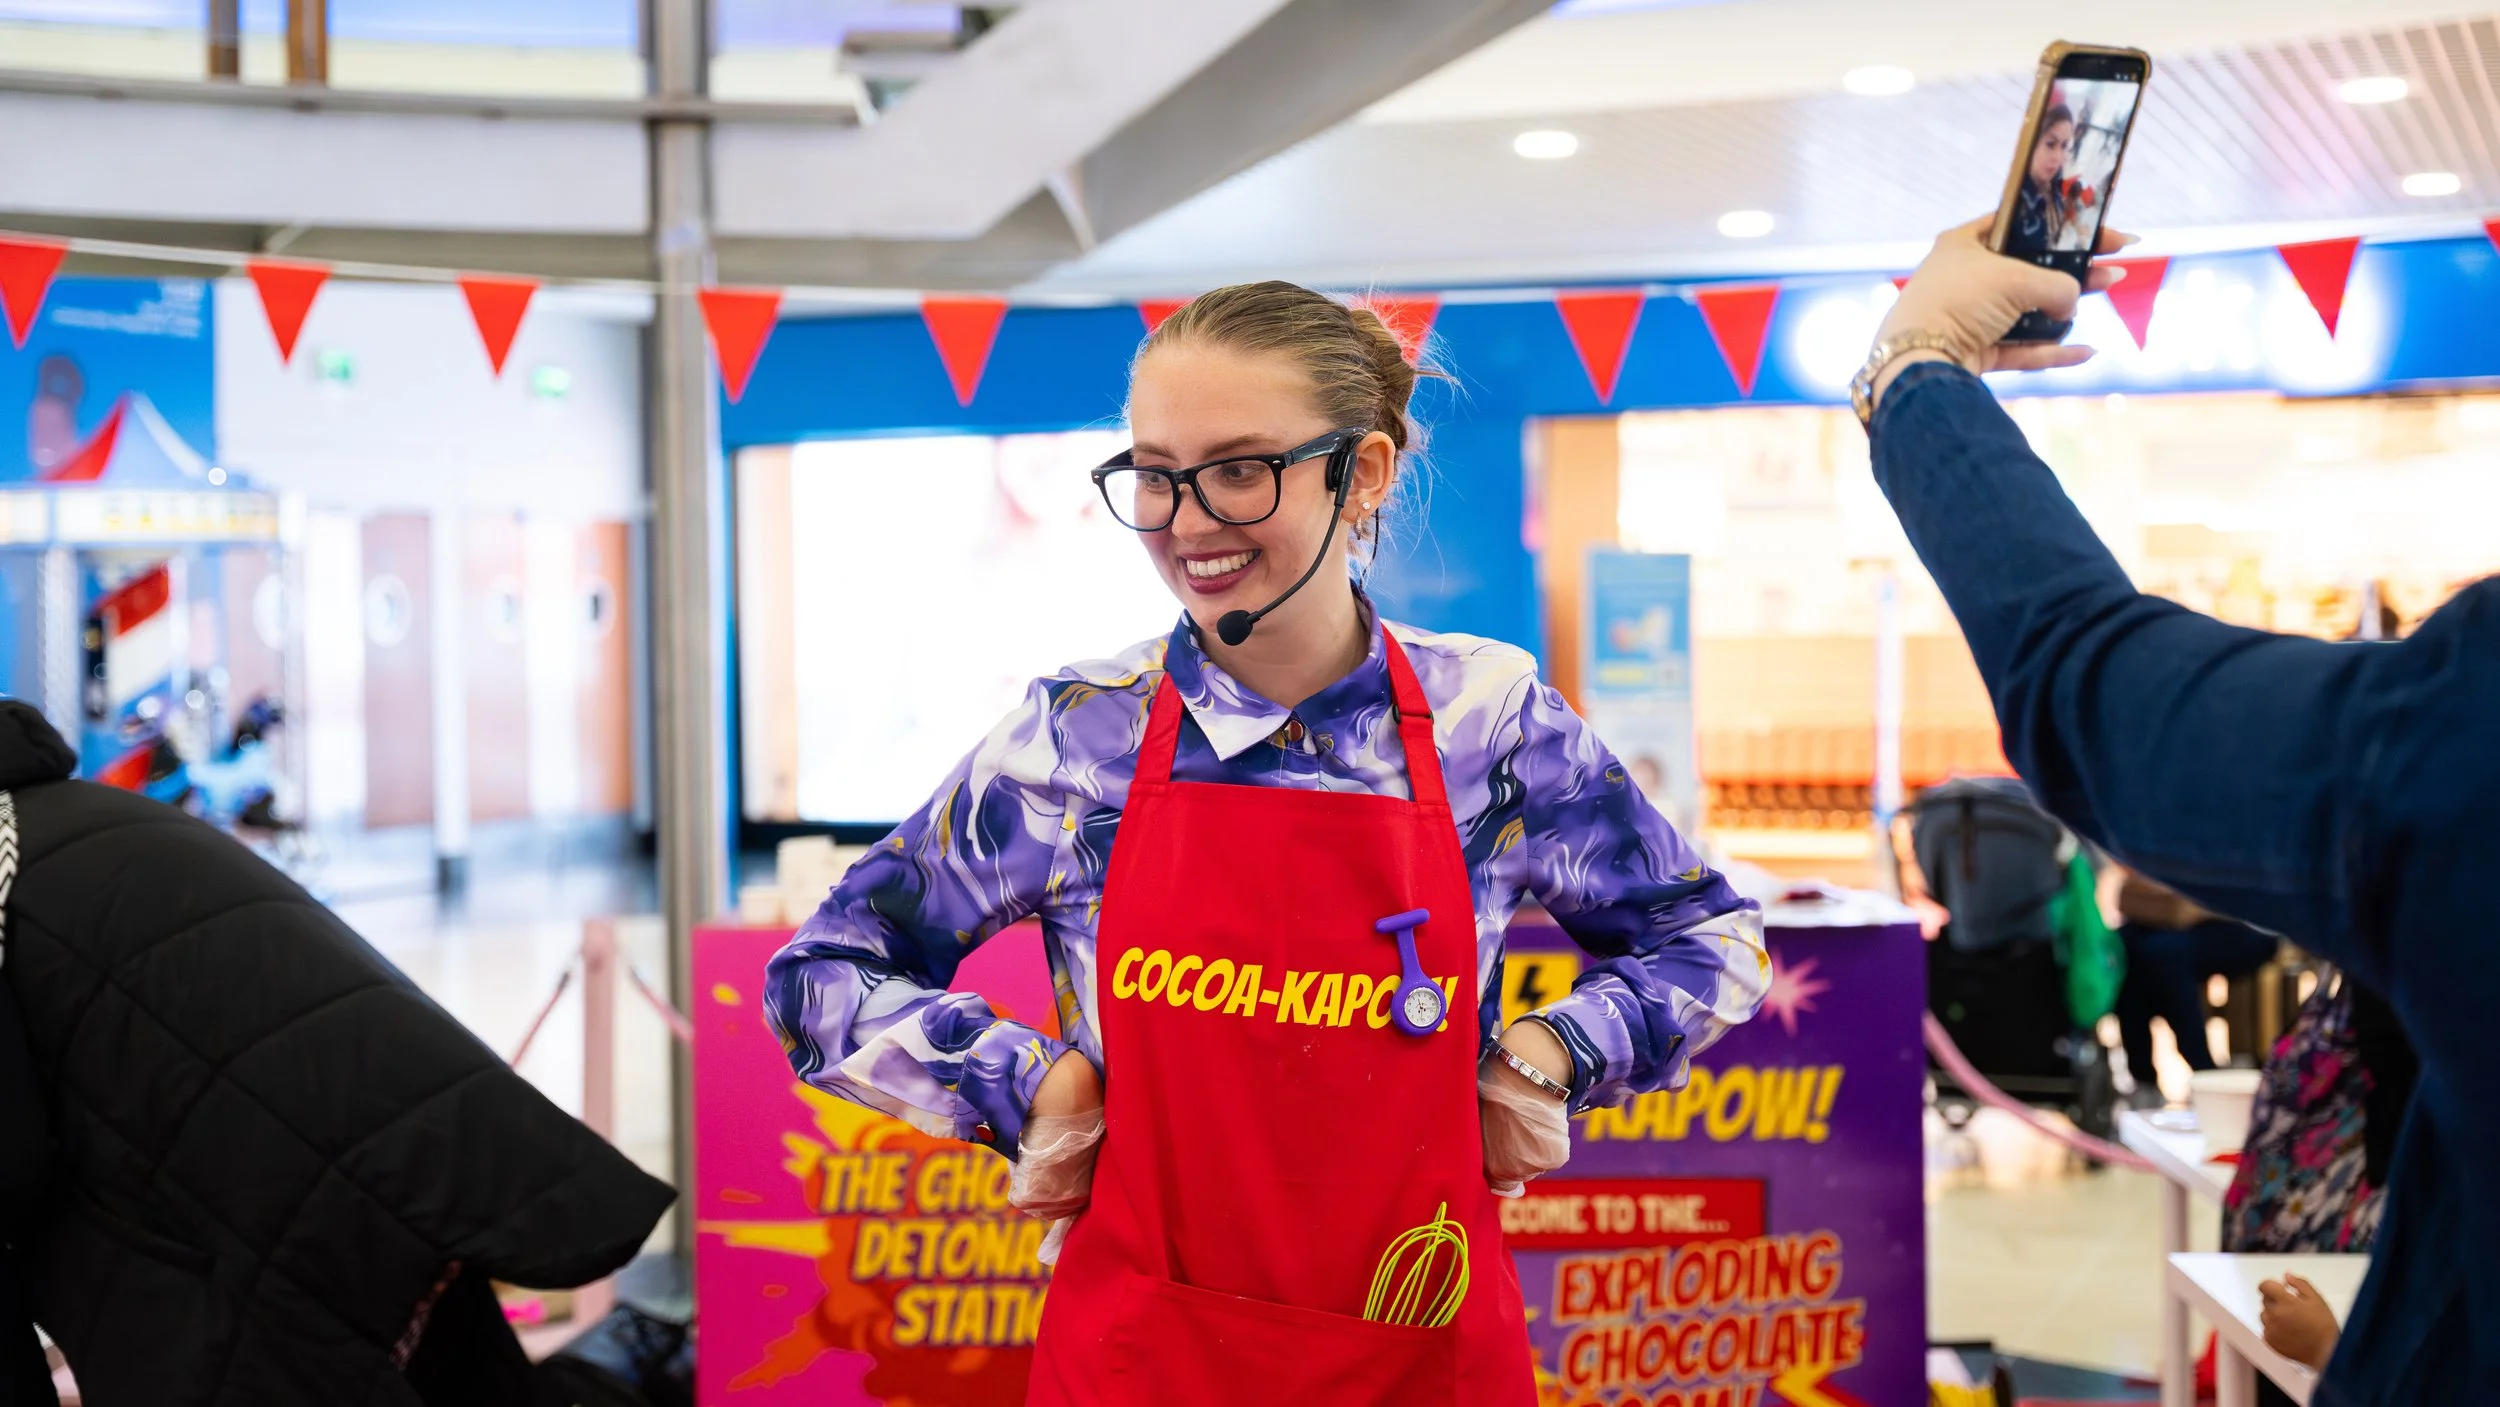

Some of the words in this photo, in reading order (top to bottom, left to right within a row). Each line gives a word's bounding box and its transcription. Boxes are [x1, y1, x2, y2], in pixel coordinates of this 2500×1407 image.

[1112, 946, 1459, 1032] COCOA-KAPO!
[822, 1153, 909, 1212] THE
[1591, 1195, 1636, 1233] TO
[854, 1219, 1055, 1278] DETONA
[1558, 1237, 1840, 1321] EXPLODING
[1567, 1304, 1862, 1387] CHOCOLATE
